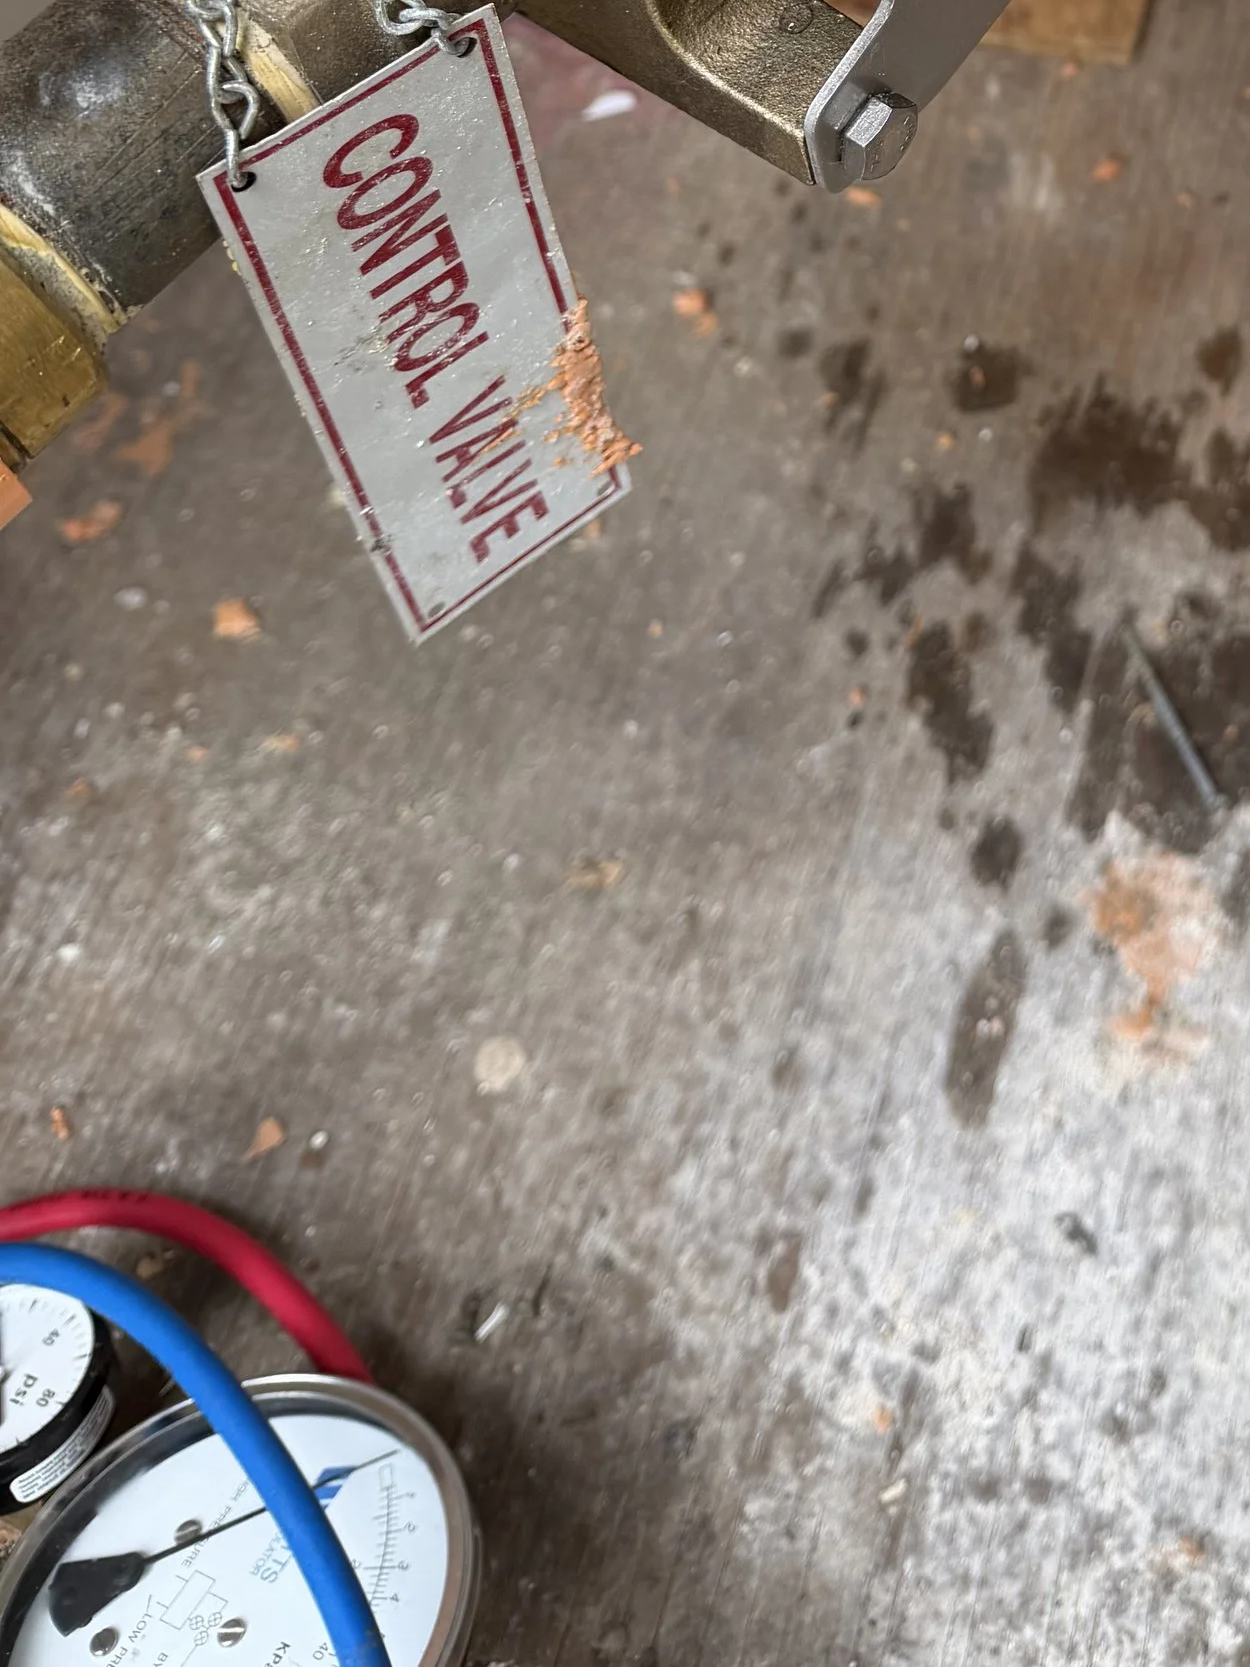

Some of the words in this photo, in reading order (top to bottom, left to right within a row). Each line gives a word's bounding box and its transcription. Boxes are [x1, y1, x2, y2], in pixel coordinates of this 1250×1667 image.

[322, 113, 490, 410] CONTROL
[428, 374, 550, 564] VALVE
[9, 1373, 38, 1407] psi
[36, 1387, 56, 1408] 80
[127, 1612, 154, 1643] LOW
